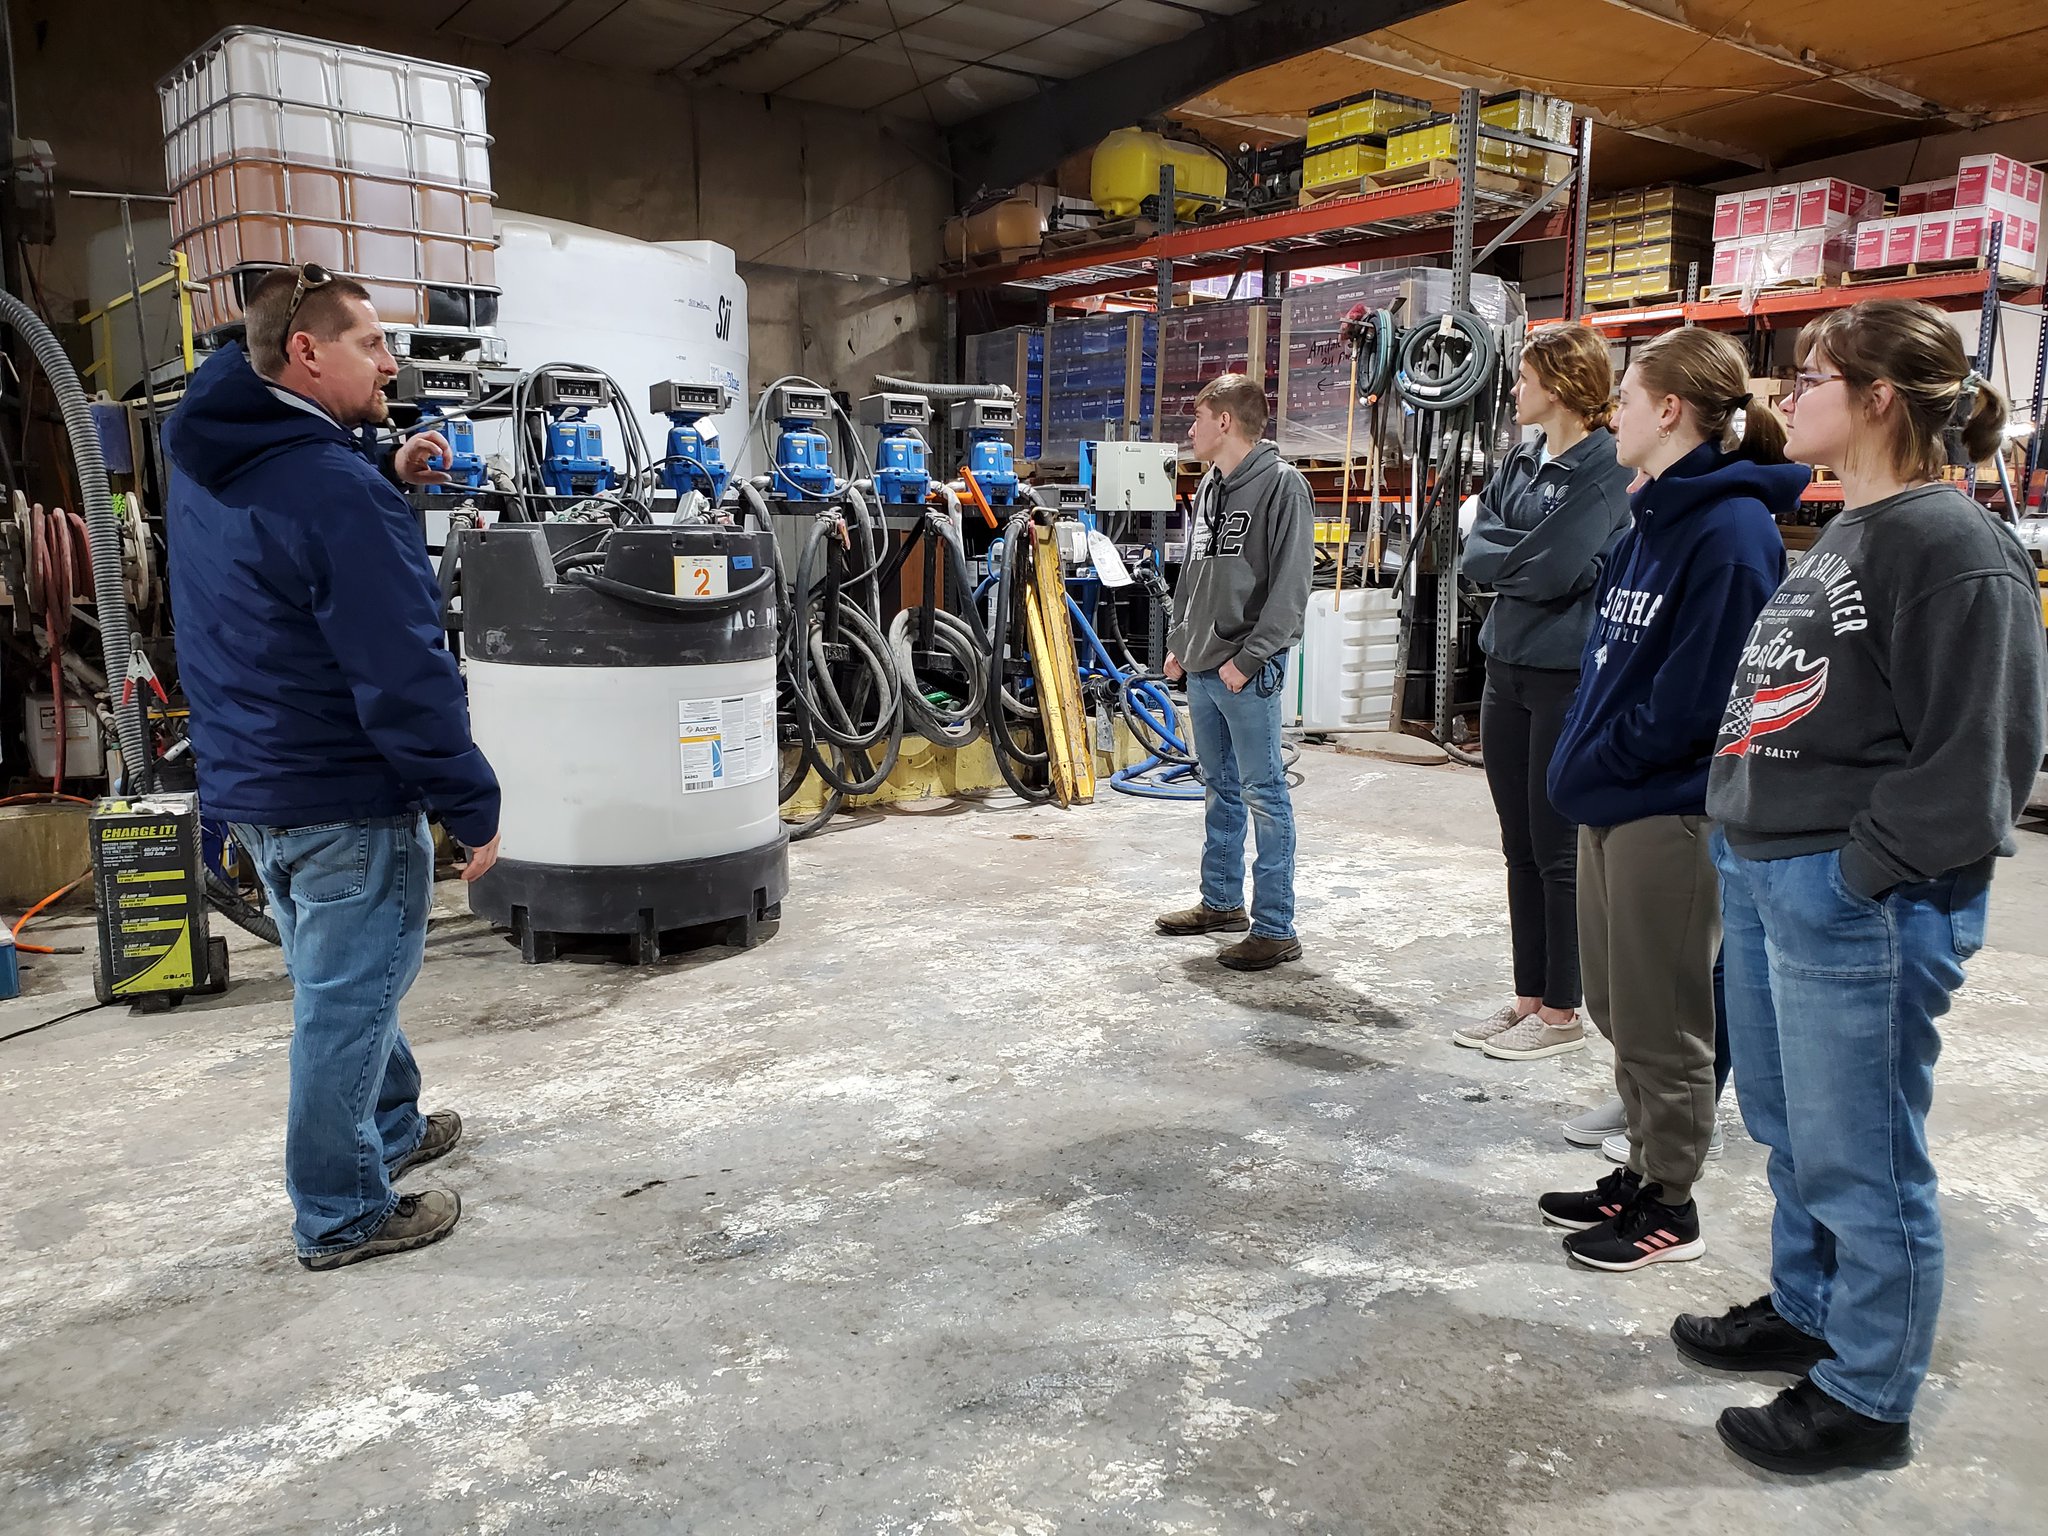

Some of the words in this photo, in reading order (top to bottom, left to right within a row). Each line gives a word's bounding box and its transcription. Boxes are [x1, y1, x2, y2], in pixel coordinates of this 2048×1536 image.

[693, 568, 711, 596] 2
[695, 724, 718, 733] Acuron
[1764, 746, 1800, 759] SALTY
[102, 825, 157, 839] CHARGE
[159, 824, 178, 836] IT!
